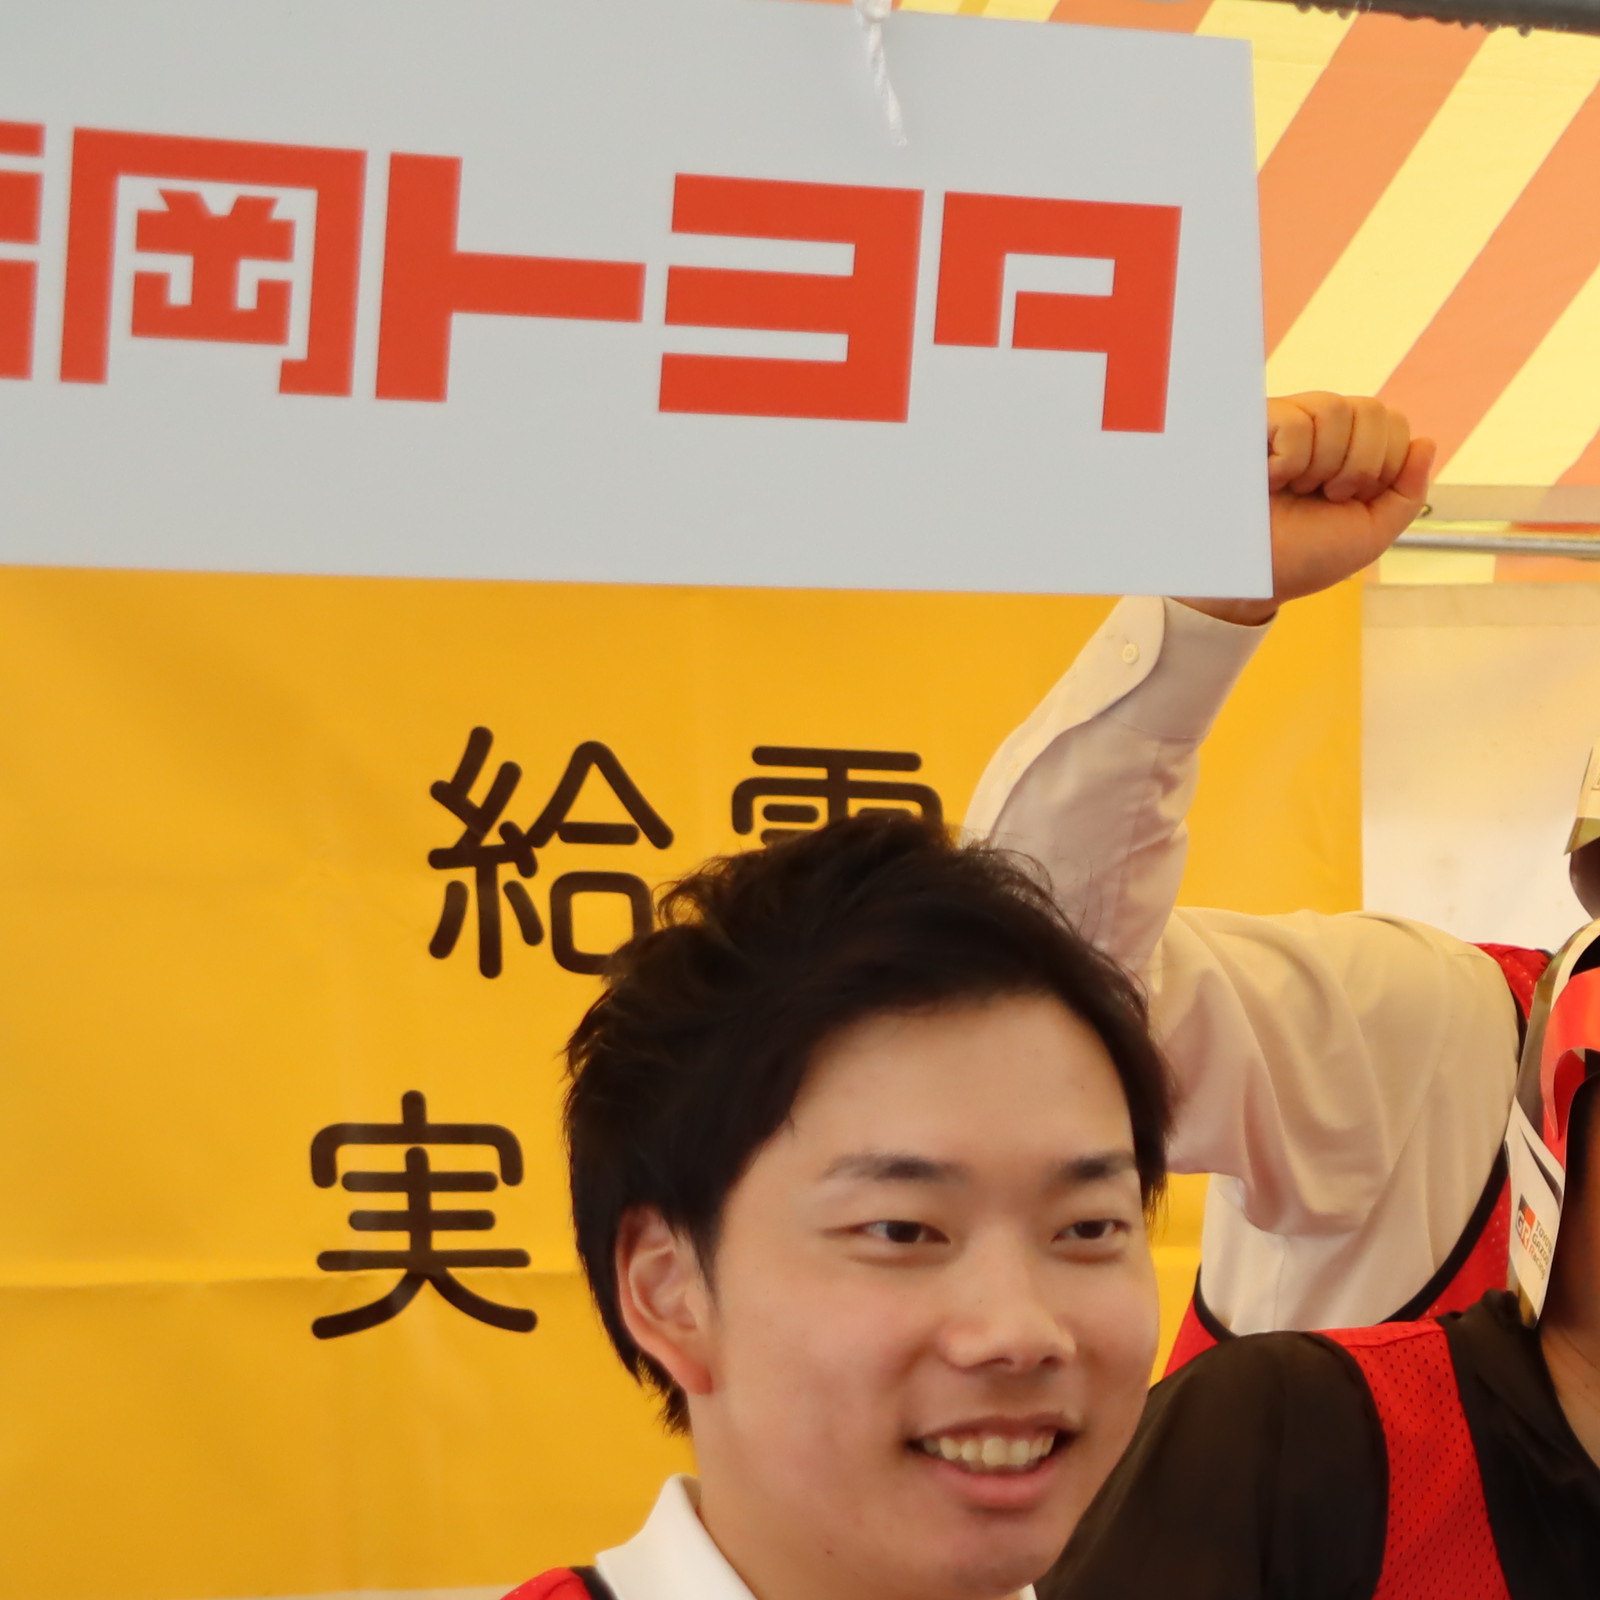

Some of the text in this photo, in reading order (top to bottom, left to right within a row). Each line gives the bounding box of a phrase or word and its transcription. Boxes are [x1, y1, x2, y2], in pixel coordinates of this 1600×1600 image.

[0, 122, 1182, 433] 岡トヨタ
[309, 1090, 538, 1339] 実
